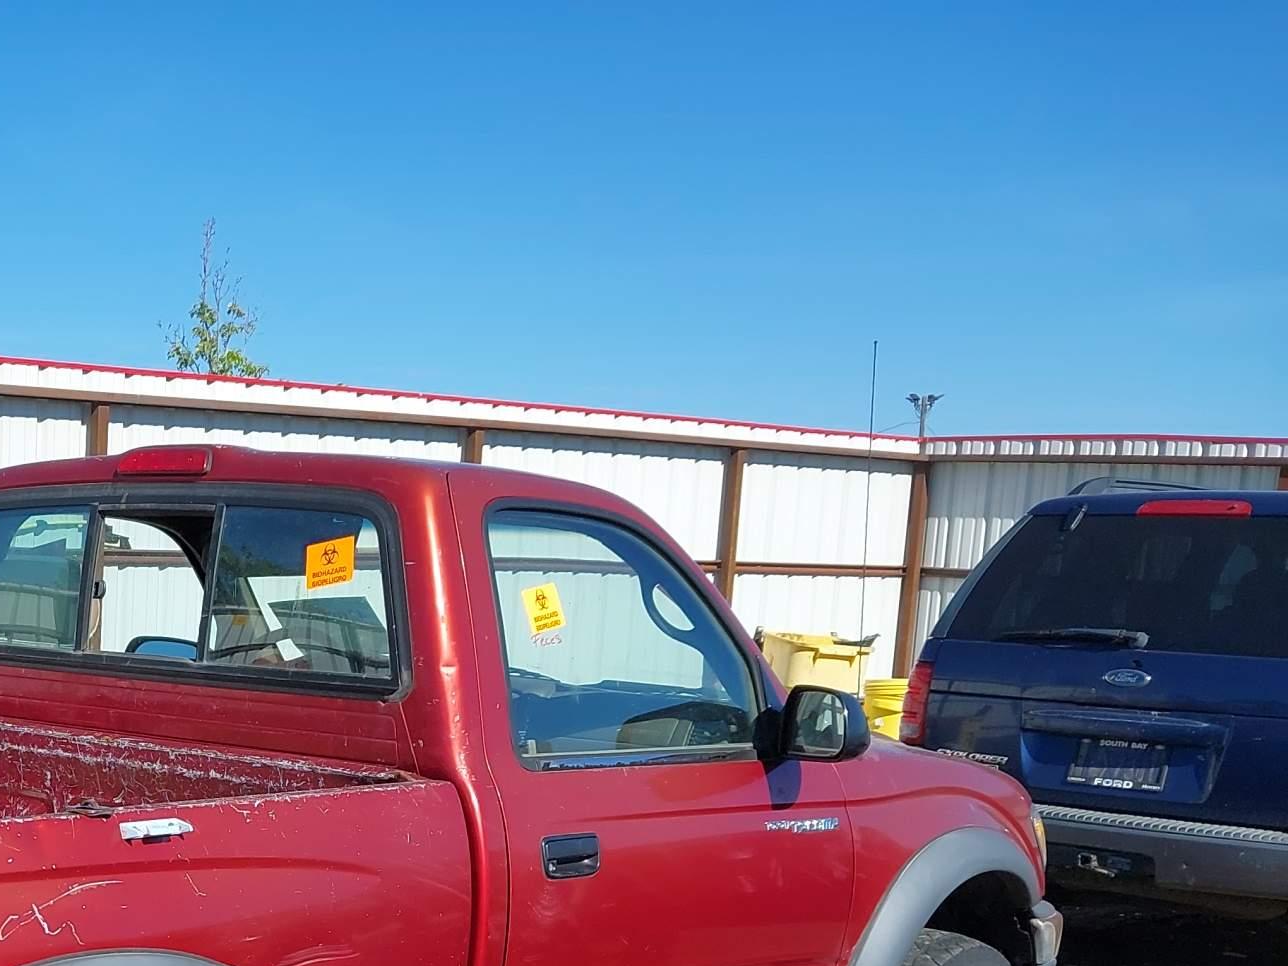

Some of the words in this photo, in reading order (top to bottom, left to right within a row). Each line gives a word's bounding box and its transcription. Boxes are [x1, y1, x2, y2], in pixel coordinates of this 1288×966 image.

[1100, 739, 1128, 748] SOUTH
[1131, 742, 1149, 750] BAY
[1093, 777, 1133, 789] FORD
